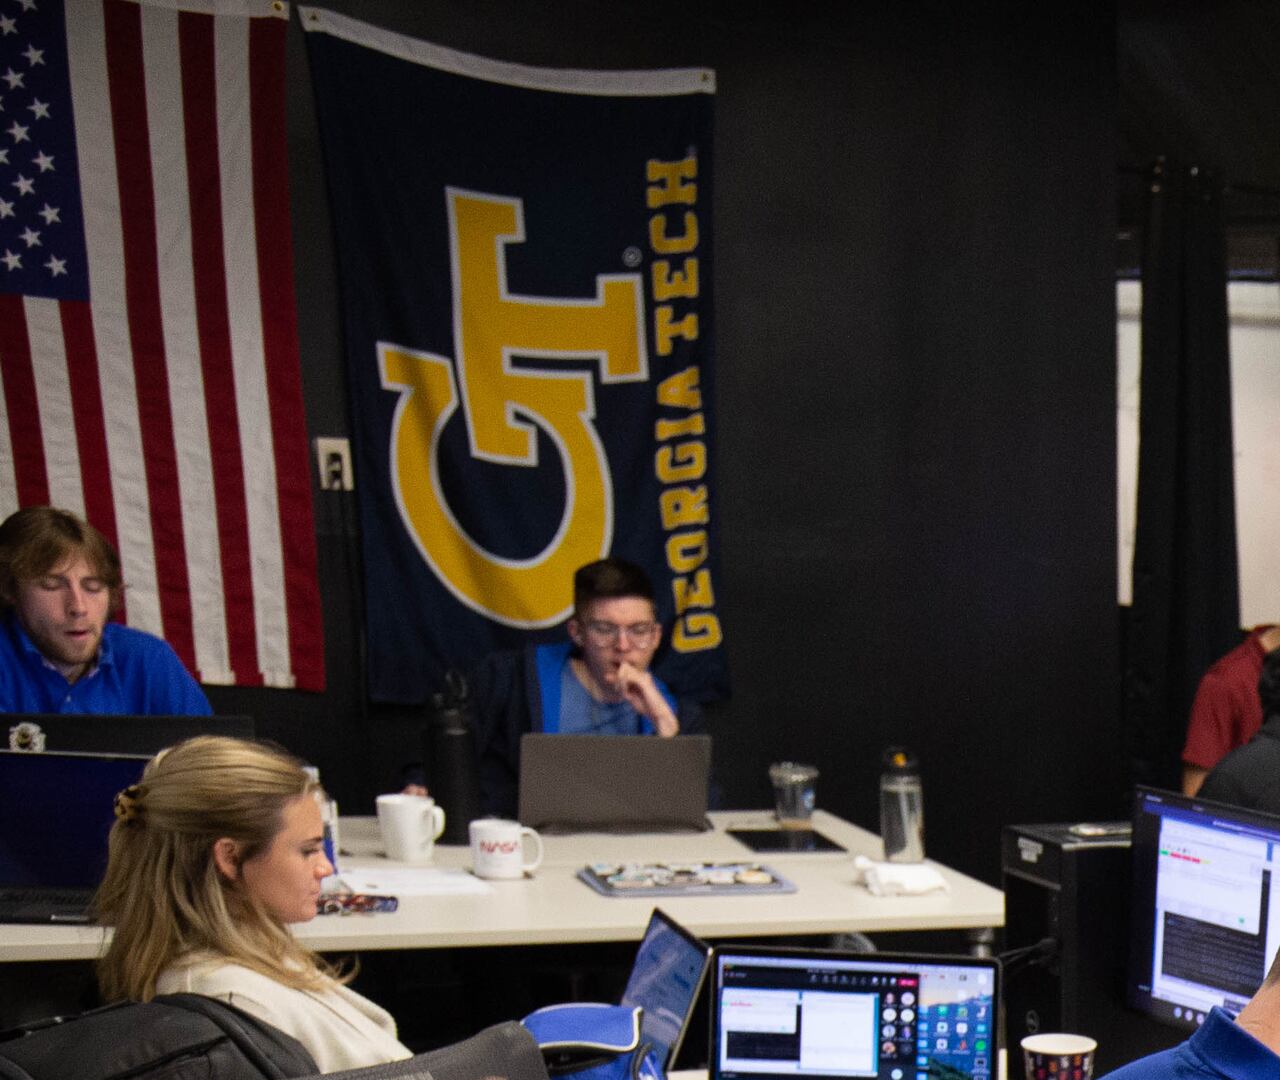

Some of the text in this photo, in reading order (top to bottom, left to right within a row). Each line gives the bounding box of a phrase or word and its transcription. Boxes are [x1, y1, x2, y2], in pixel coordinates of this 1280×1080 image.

[647, 156, 722, 654] GEORGIA TECH
[479, 840, 520, 854] NASA
